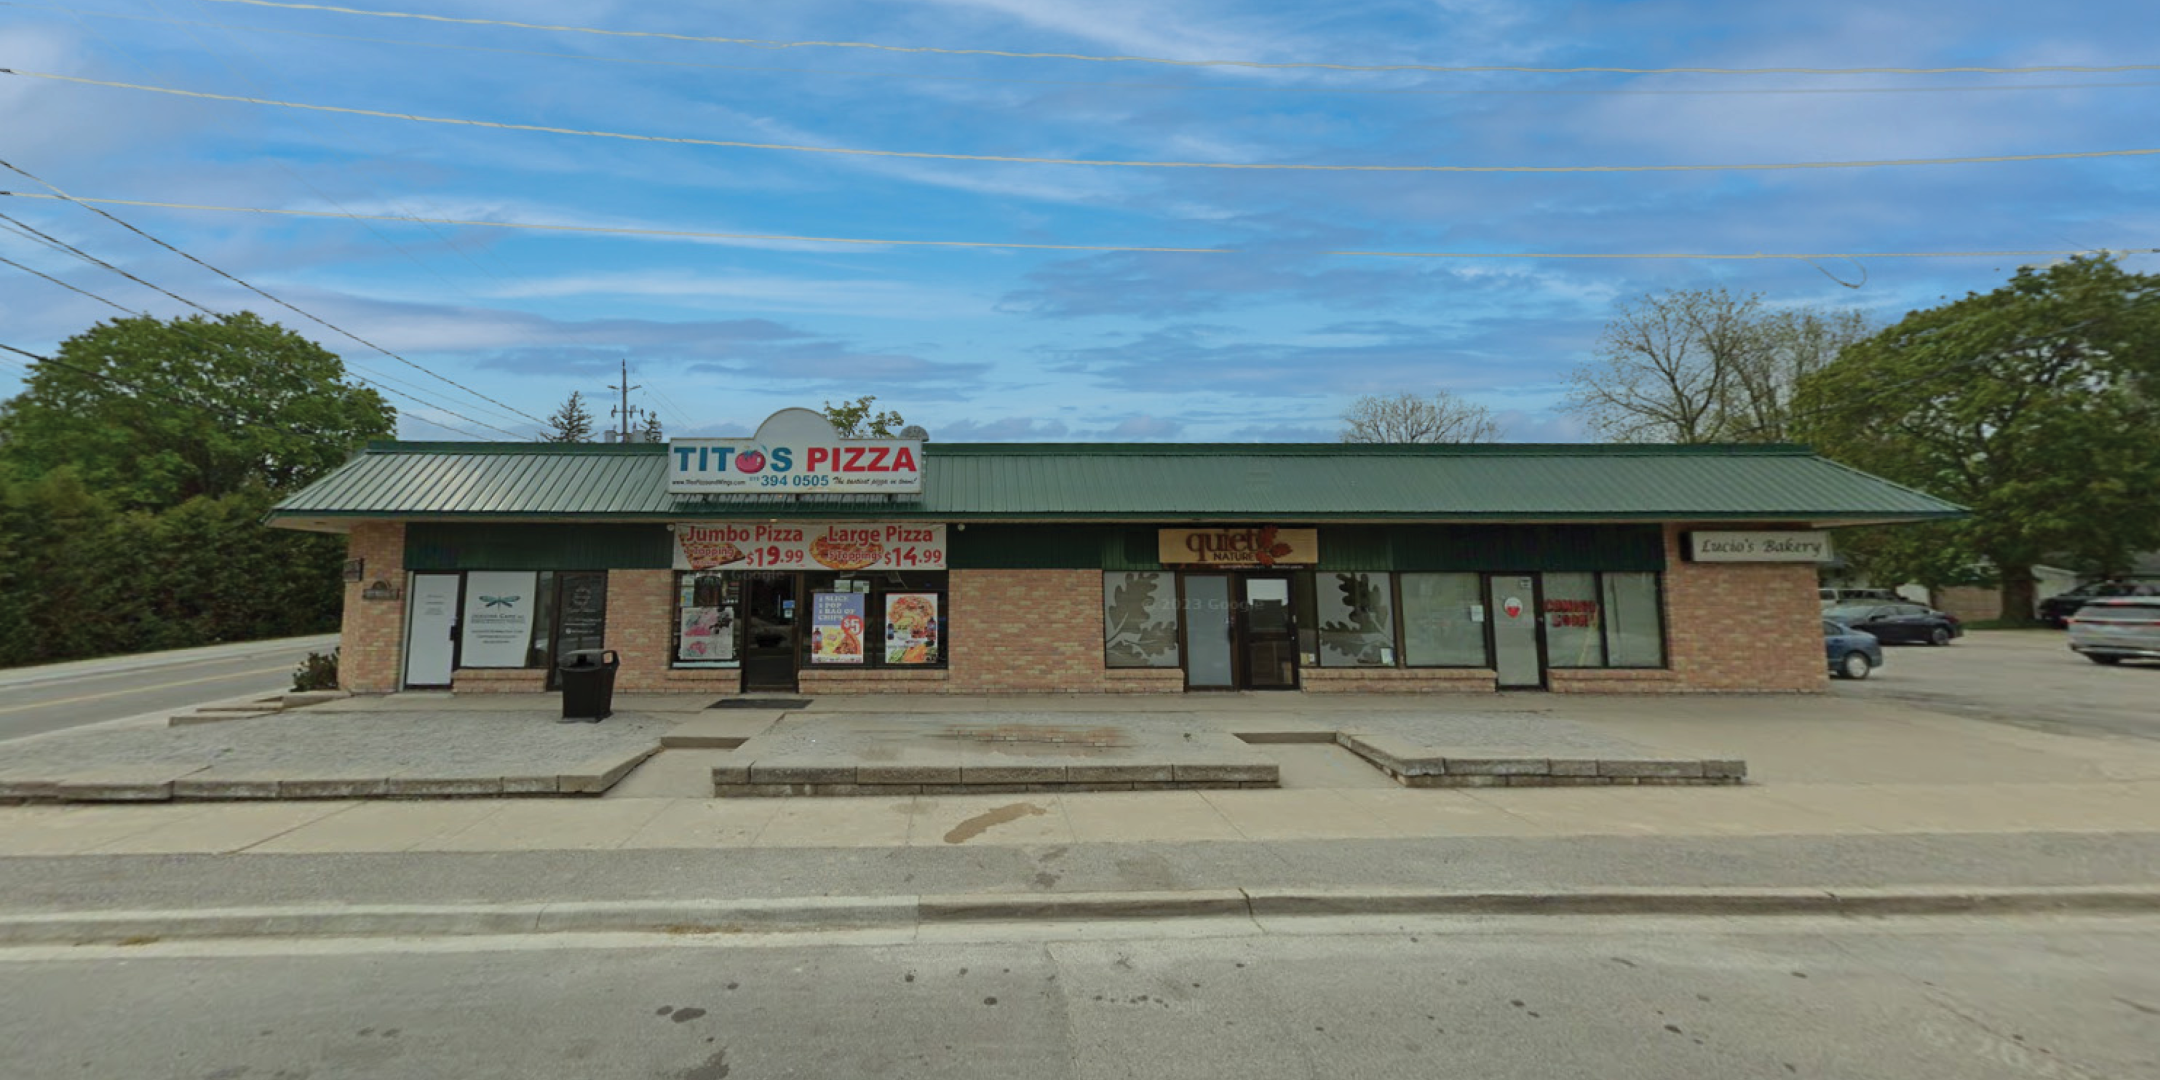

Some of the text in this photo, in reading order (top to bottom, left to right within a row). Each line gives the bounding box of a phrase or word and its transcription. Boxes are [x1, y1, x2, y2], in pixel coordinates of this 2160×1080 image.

[806, 446, 918, 472] PIZZA
[760, 474, 788, 488] 394
[792, 474, 829, 488] 0505
[686, 524, 804, 542] Jumbo Pizza
[828, 525, 934, 547] Large Pizza
[692, 547, 735, 559] Topping
[1185, 528, 1260, 562] quiet
[1701, 538, 1822, 558] Lucio's Bakery
[746, 545, 804, 567] $19.99
[884, 546, 943, 567] $14.99
[1213, 551, 1257, 562] NATURE
[843, 618, 861, 635] $5
